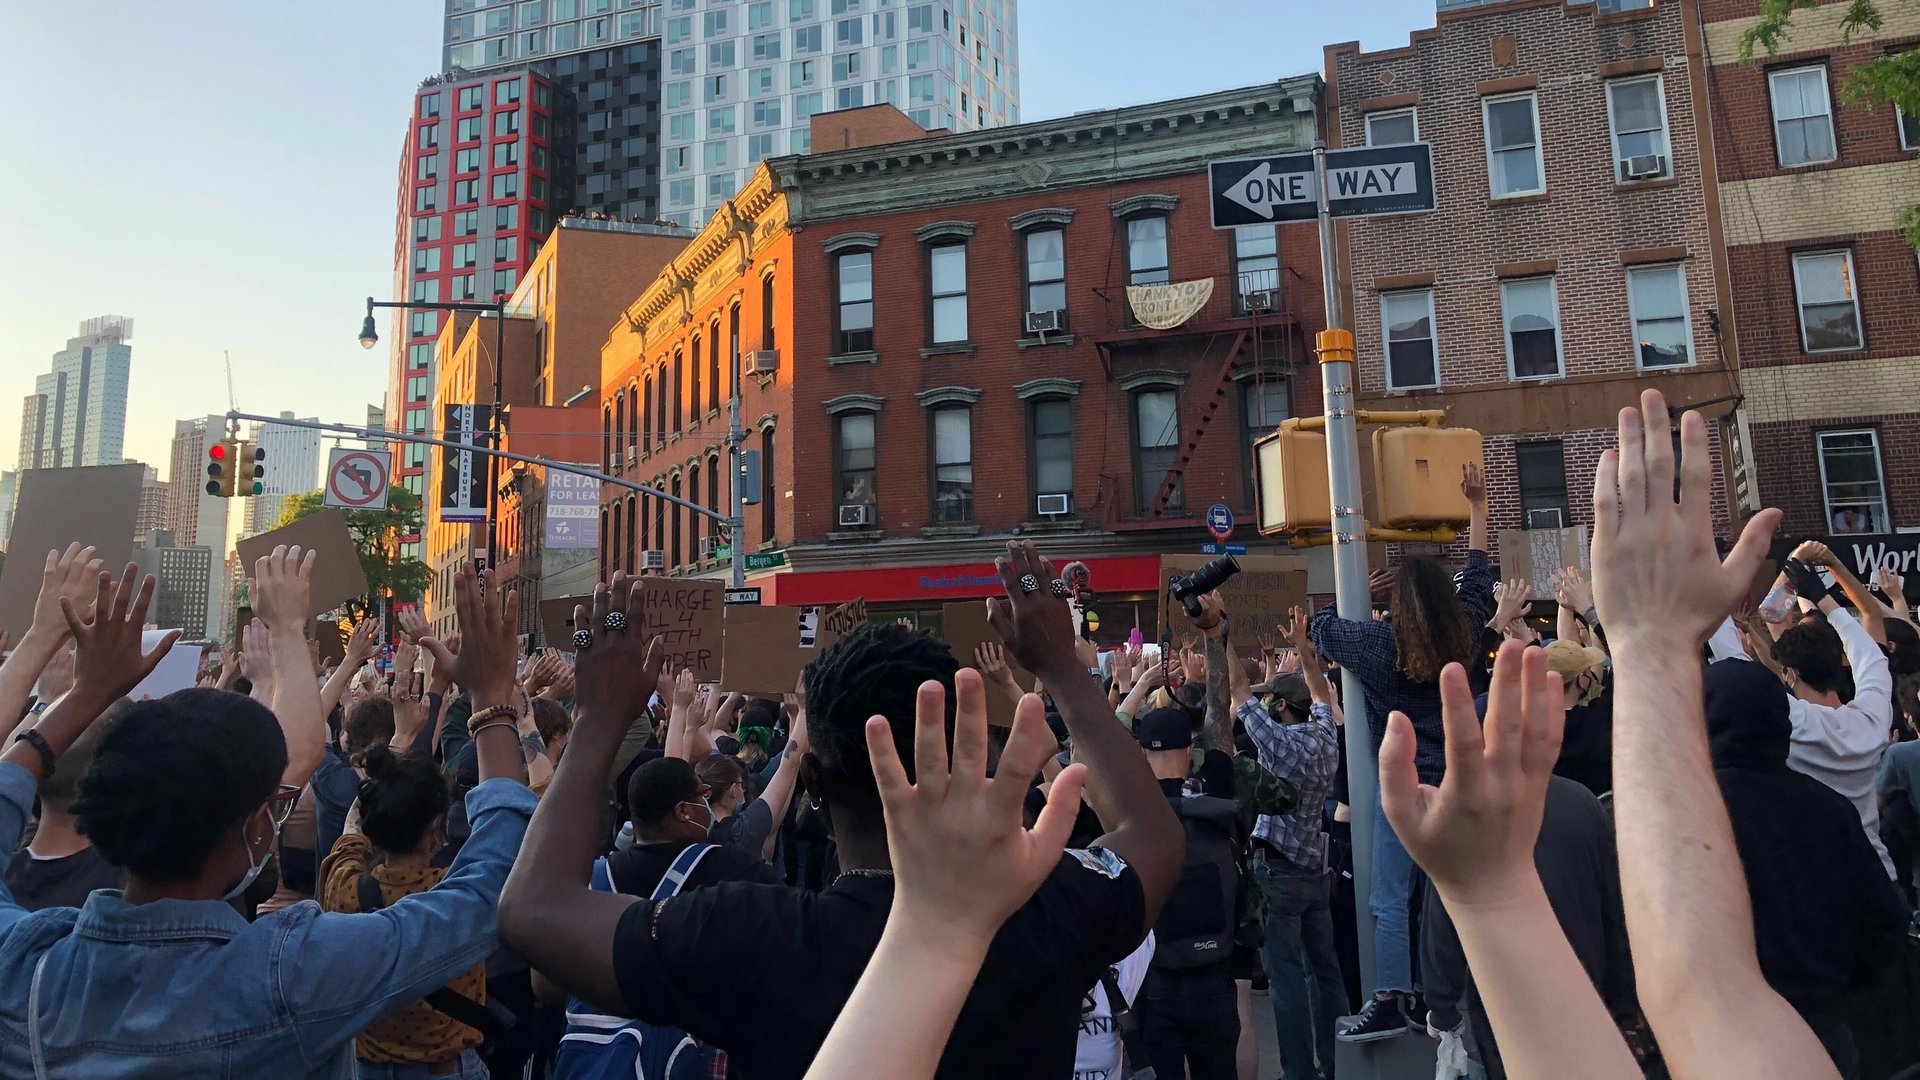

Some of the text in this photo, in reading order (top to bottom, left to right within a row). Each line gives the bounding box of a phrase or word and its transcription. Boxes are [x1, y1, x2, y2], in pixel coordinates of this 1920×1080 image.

[1245, 166, 1402, 204] ONE WAY
[1129, 281, 1211, 301] THANK YOU
[461, 451, 469, 499] LATBUSH
[551, 473, 600, 488] RETAI
[550, 490, 600, 500] FOR LEA
[549, 507, 599, 516] 718-768-77
[749, 555, 772, 568] Bergen
[478, 559, 486, 594] PARK
[646, 588, 714, 611] HARGE
[739, 592, 756, 600] WAY
[1222, 593, 1271, 610] PORTS
[678, 610, 694, 629] 4
[661, 648, 712, 675] RDER
